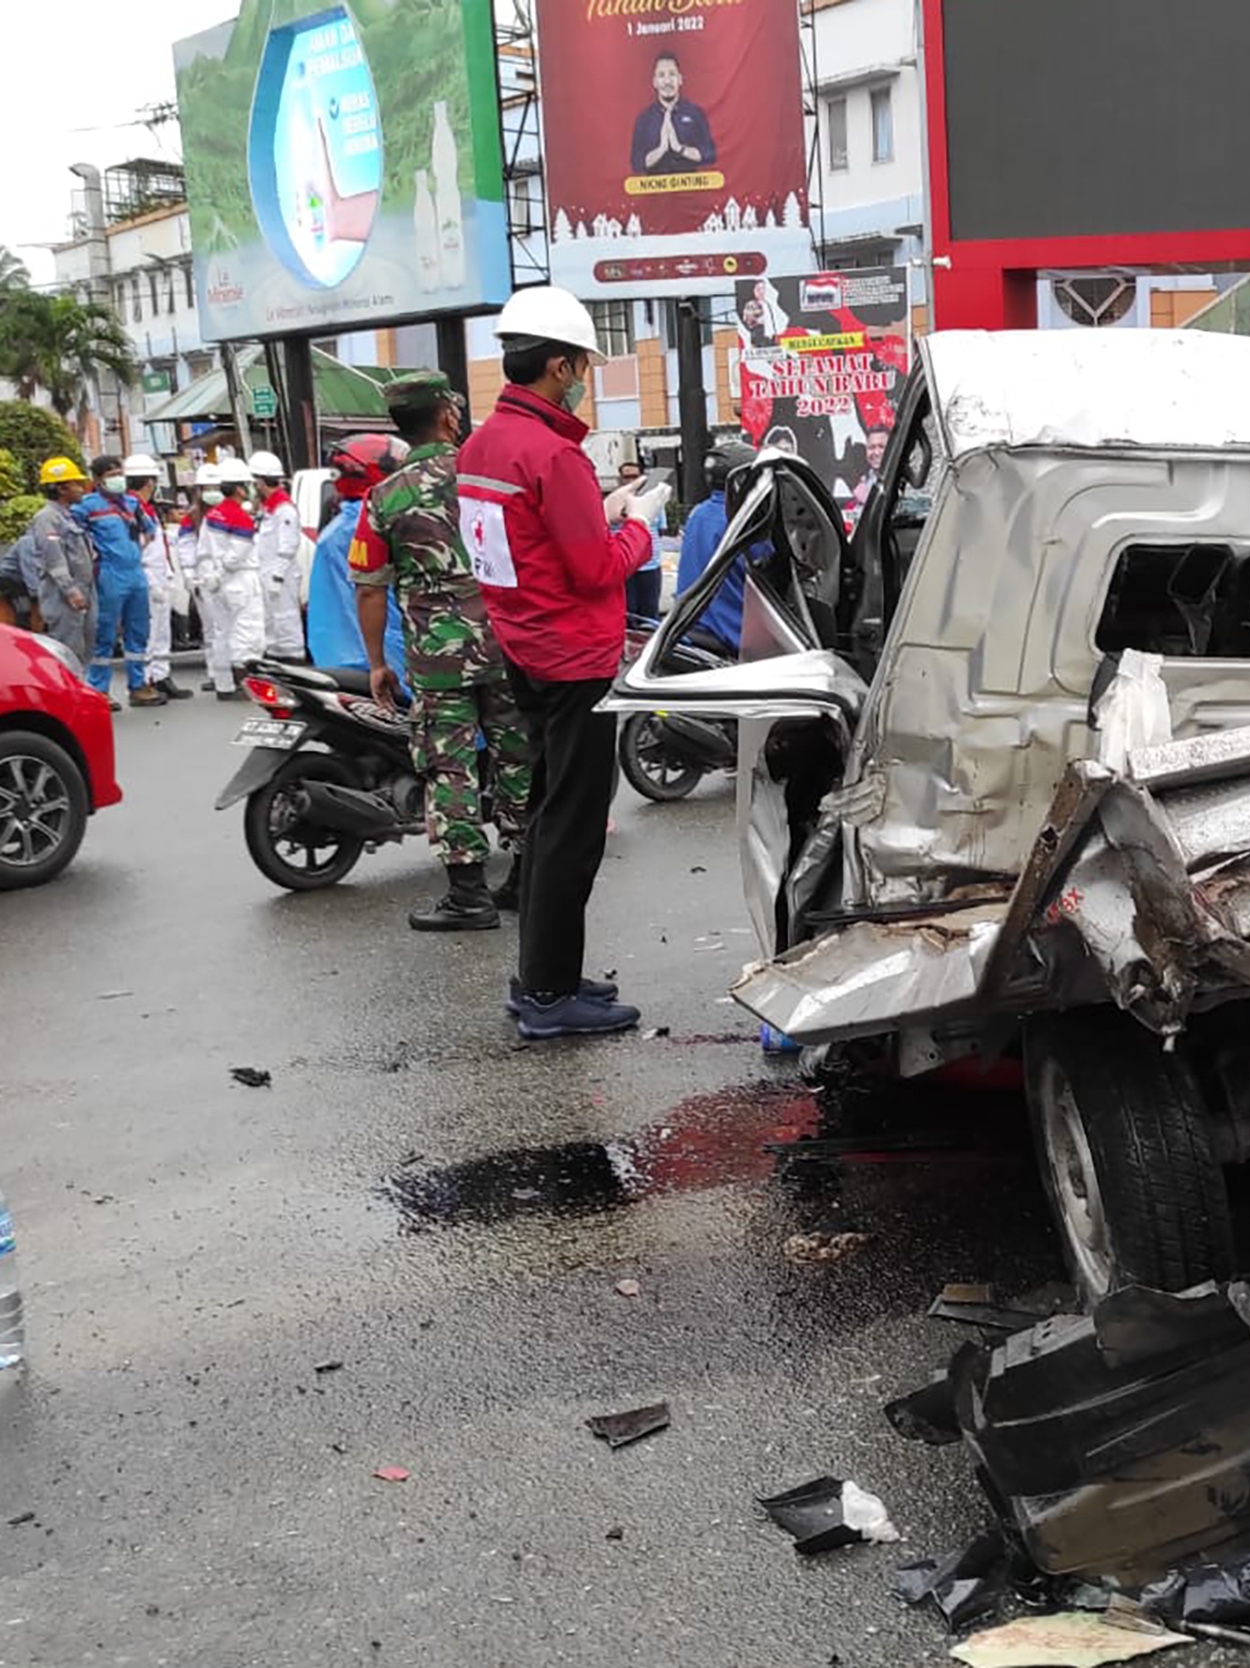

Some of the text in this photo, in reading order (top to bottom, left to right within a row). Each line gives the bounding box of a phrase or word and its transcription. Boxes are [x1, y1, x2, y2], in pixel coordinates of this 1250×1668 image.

[627, 16, 704, 35] 1 Januari 2022
[772, 353, 873, 376] SELAMAT
[749, 369, 897, 397] TAHUN BARU
[796, 396, 851, 417] 2022
